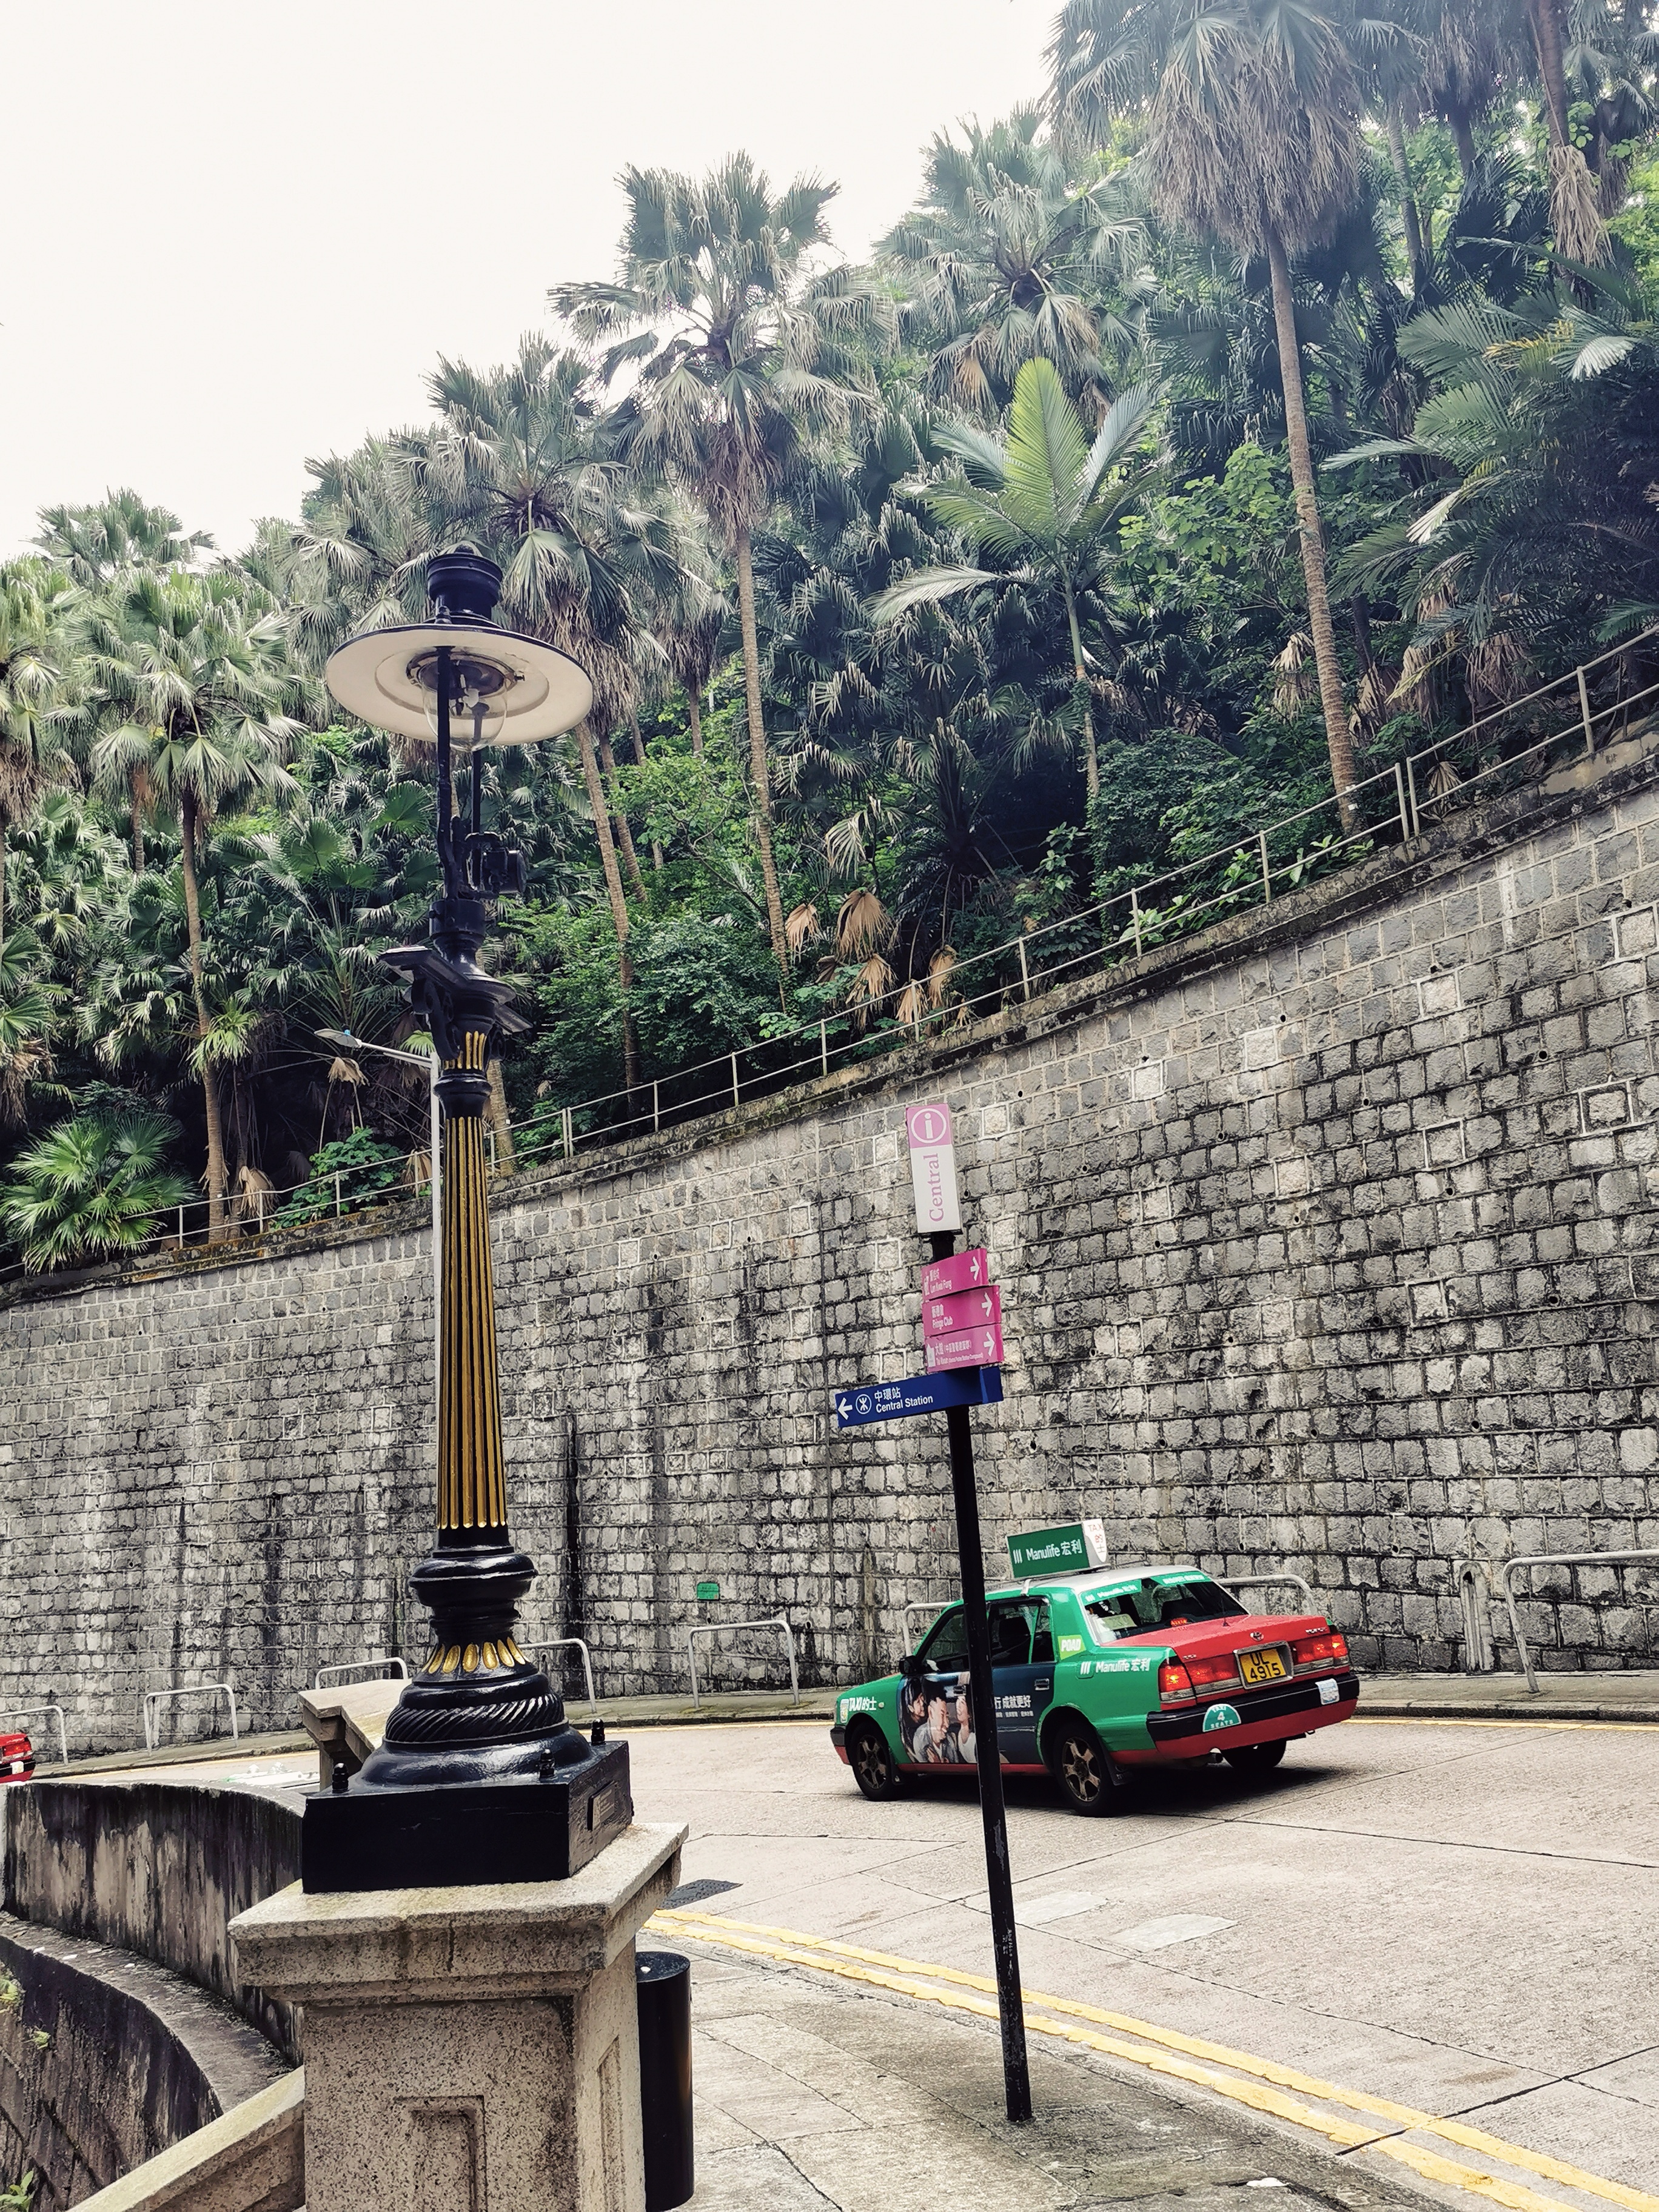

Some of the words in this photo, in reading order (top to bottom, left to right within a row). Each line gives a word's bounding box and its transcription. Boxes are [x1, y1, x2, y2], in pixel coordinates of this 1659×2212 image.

[923, 1153, 944, 1222] Central
[943, 1316, 953, 1327] Club
[874, 1386, 901, 1402] 中環站
[876, 1399, 903, 1413] Central
[905, 1395, 934, 1408] Station
[1088, 1523, 1104, 1532] TAX
[1025, 1543, 1061, 1561] Manulife
[1061, 1539, 1083, 1556] 宏利
[1061, 1638, 1082, 1652] POAD
[1095, 1659, 1130, 1674] Manulife
[1130, 1657, 1151, 1672] 宏利
[1250, 1652, 1270, 1666] UL
[1250, 1662, 1281, 1681] 4915
[1217, 1711, 1225, 1721] 4
[1210, 1720, 1233, 1729] SEATS
